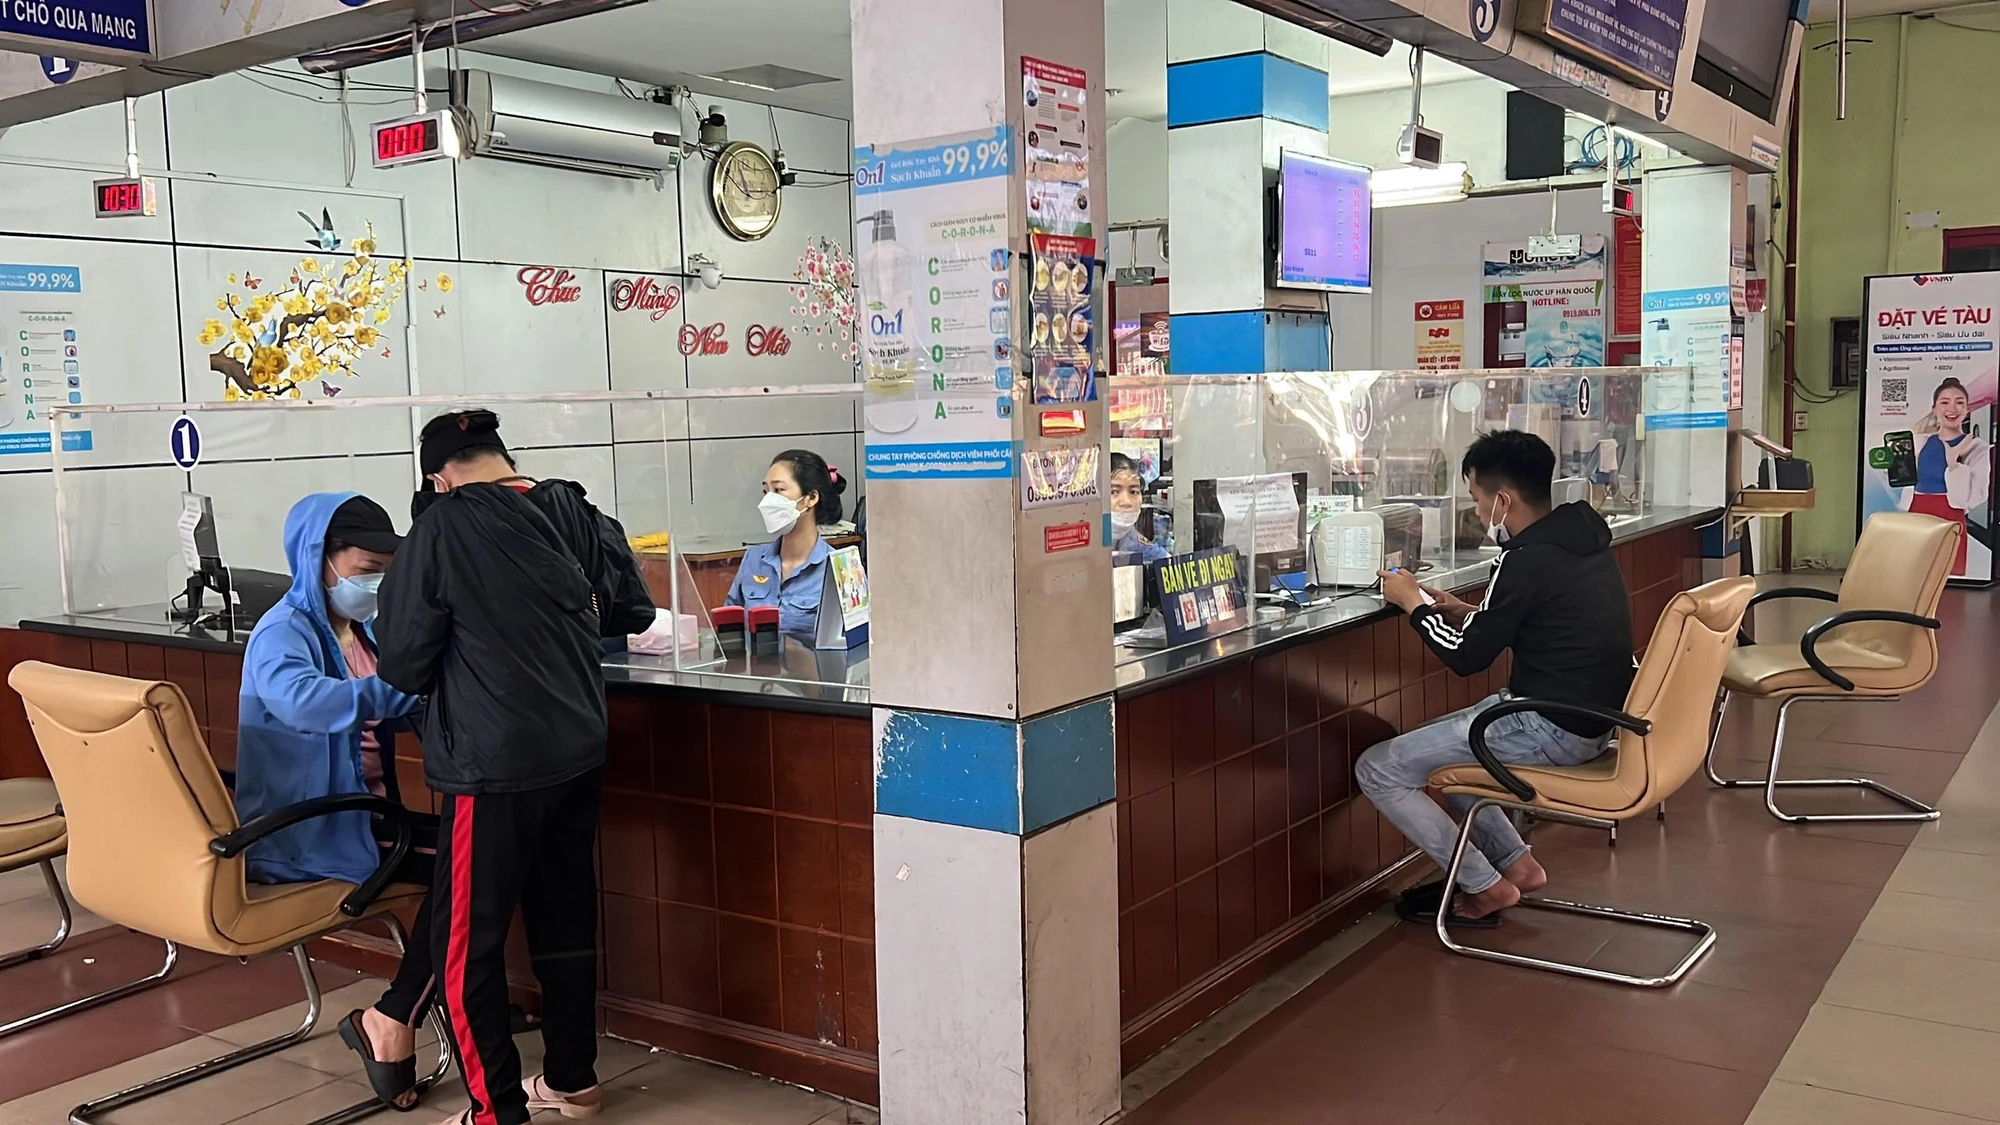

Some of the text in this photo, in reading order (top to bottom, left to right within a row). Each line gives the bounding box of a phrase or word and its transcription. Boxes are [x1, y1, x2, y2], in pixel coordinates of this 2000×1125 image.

[54, 6, 88, 32] QUA
[91, 12, 137, 40] MẠNG
[942, 139, 1008, 176] 99,9%
[855, 161, 885, 187] On1
[28, 272, 75, 290] 99,9%
[1573, 286, 1595, 295] QUỐC
[1929, 275, 1954, 283] VNPAY
[518, 266, 681, 321] Chúc Mừng
[1532, 297, 1570, 307] HOTLINE:
[871, 308, 904, 336] On1
[1878, 305, 1991, 330] ĐẶT VÉ TÀU
[679, 322, 792, 356] Năm Mới
[1355, 394, 1368, 431] 3
[177, 422, 195, 463] 1
[868, 451, 891, 461] CHUNG
[891, 451, 903, 461] TAY
[903, 449, 927, 460] PHÒNG
[927, 448, 951, 460] CHỐNG
[951, 450, 967, 460] DỊCH
[967, 448, 984, 459] VIÊM
[984, 447, 1000, 459] PHỔI
[1160, 552, 1236, 594] BÁN VÉ ĐI NGAY
